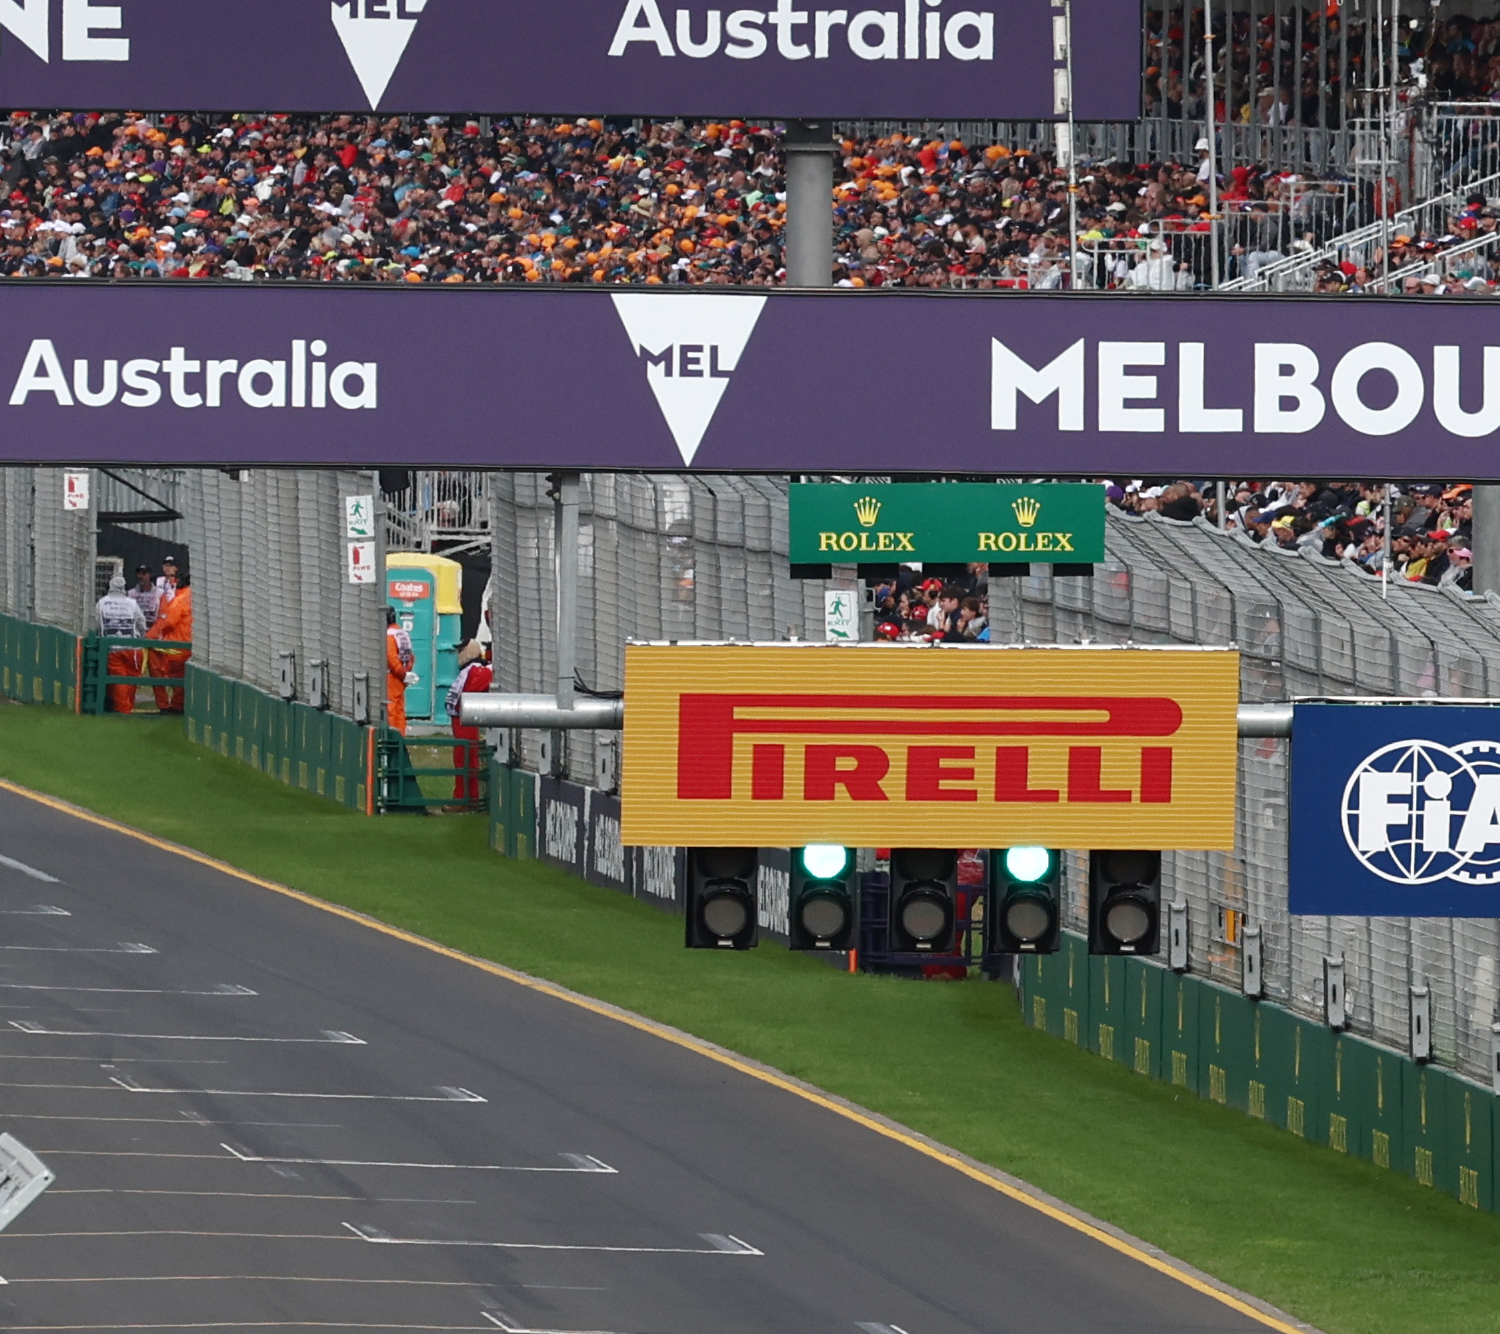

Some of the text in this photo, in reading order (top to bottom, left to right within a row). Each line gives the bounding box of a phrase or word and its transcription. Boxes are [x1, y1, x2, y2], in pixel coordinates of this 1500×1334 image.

[8, 339, 377, 410] Australia
[639, 343, 732, 380] MEL
[818, 533, 915, 552] ROLEX
[978, 533, 1074, 552] ROLEX
[676, 693, 1183, 804] PIRELLI
